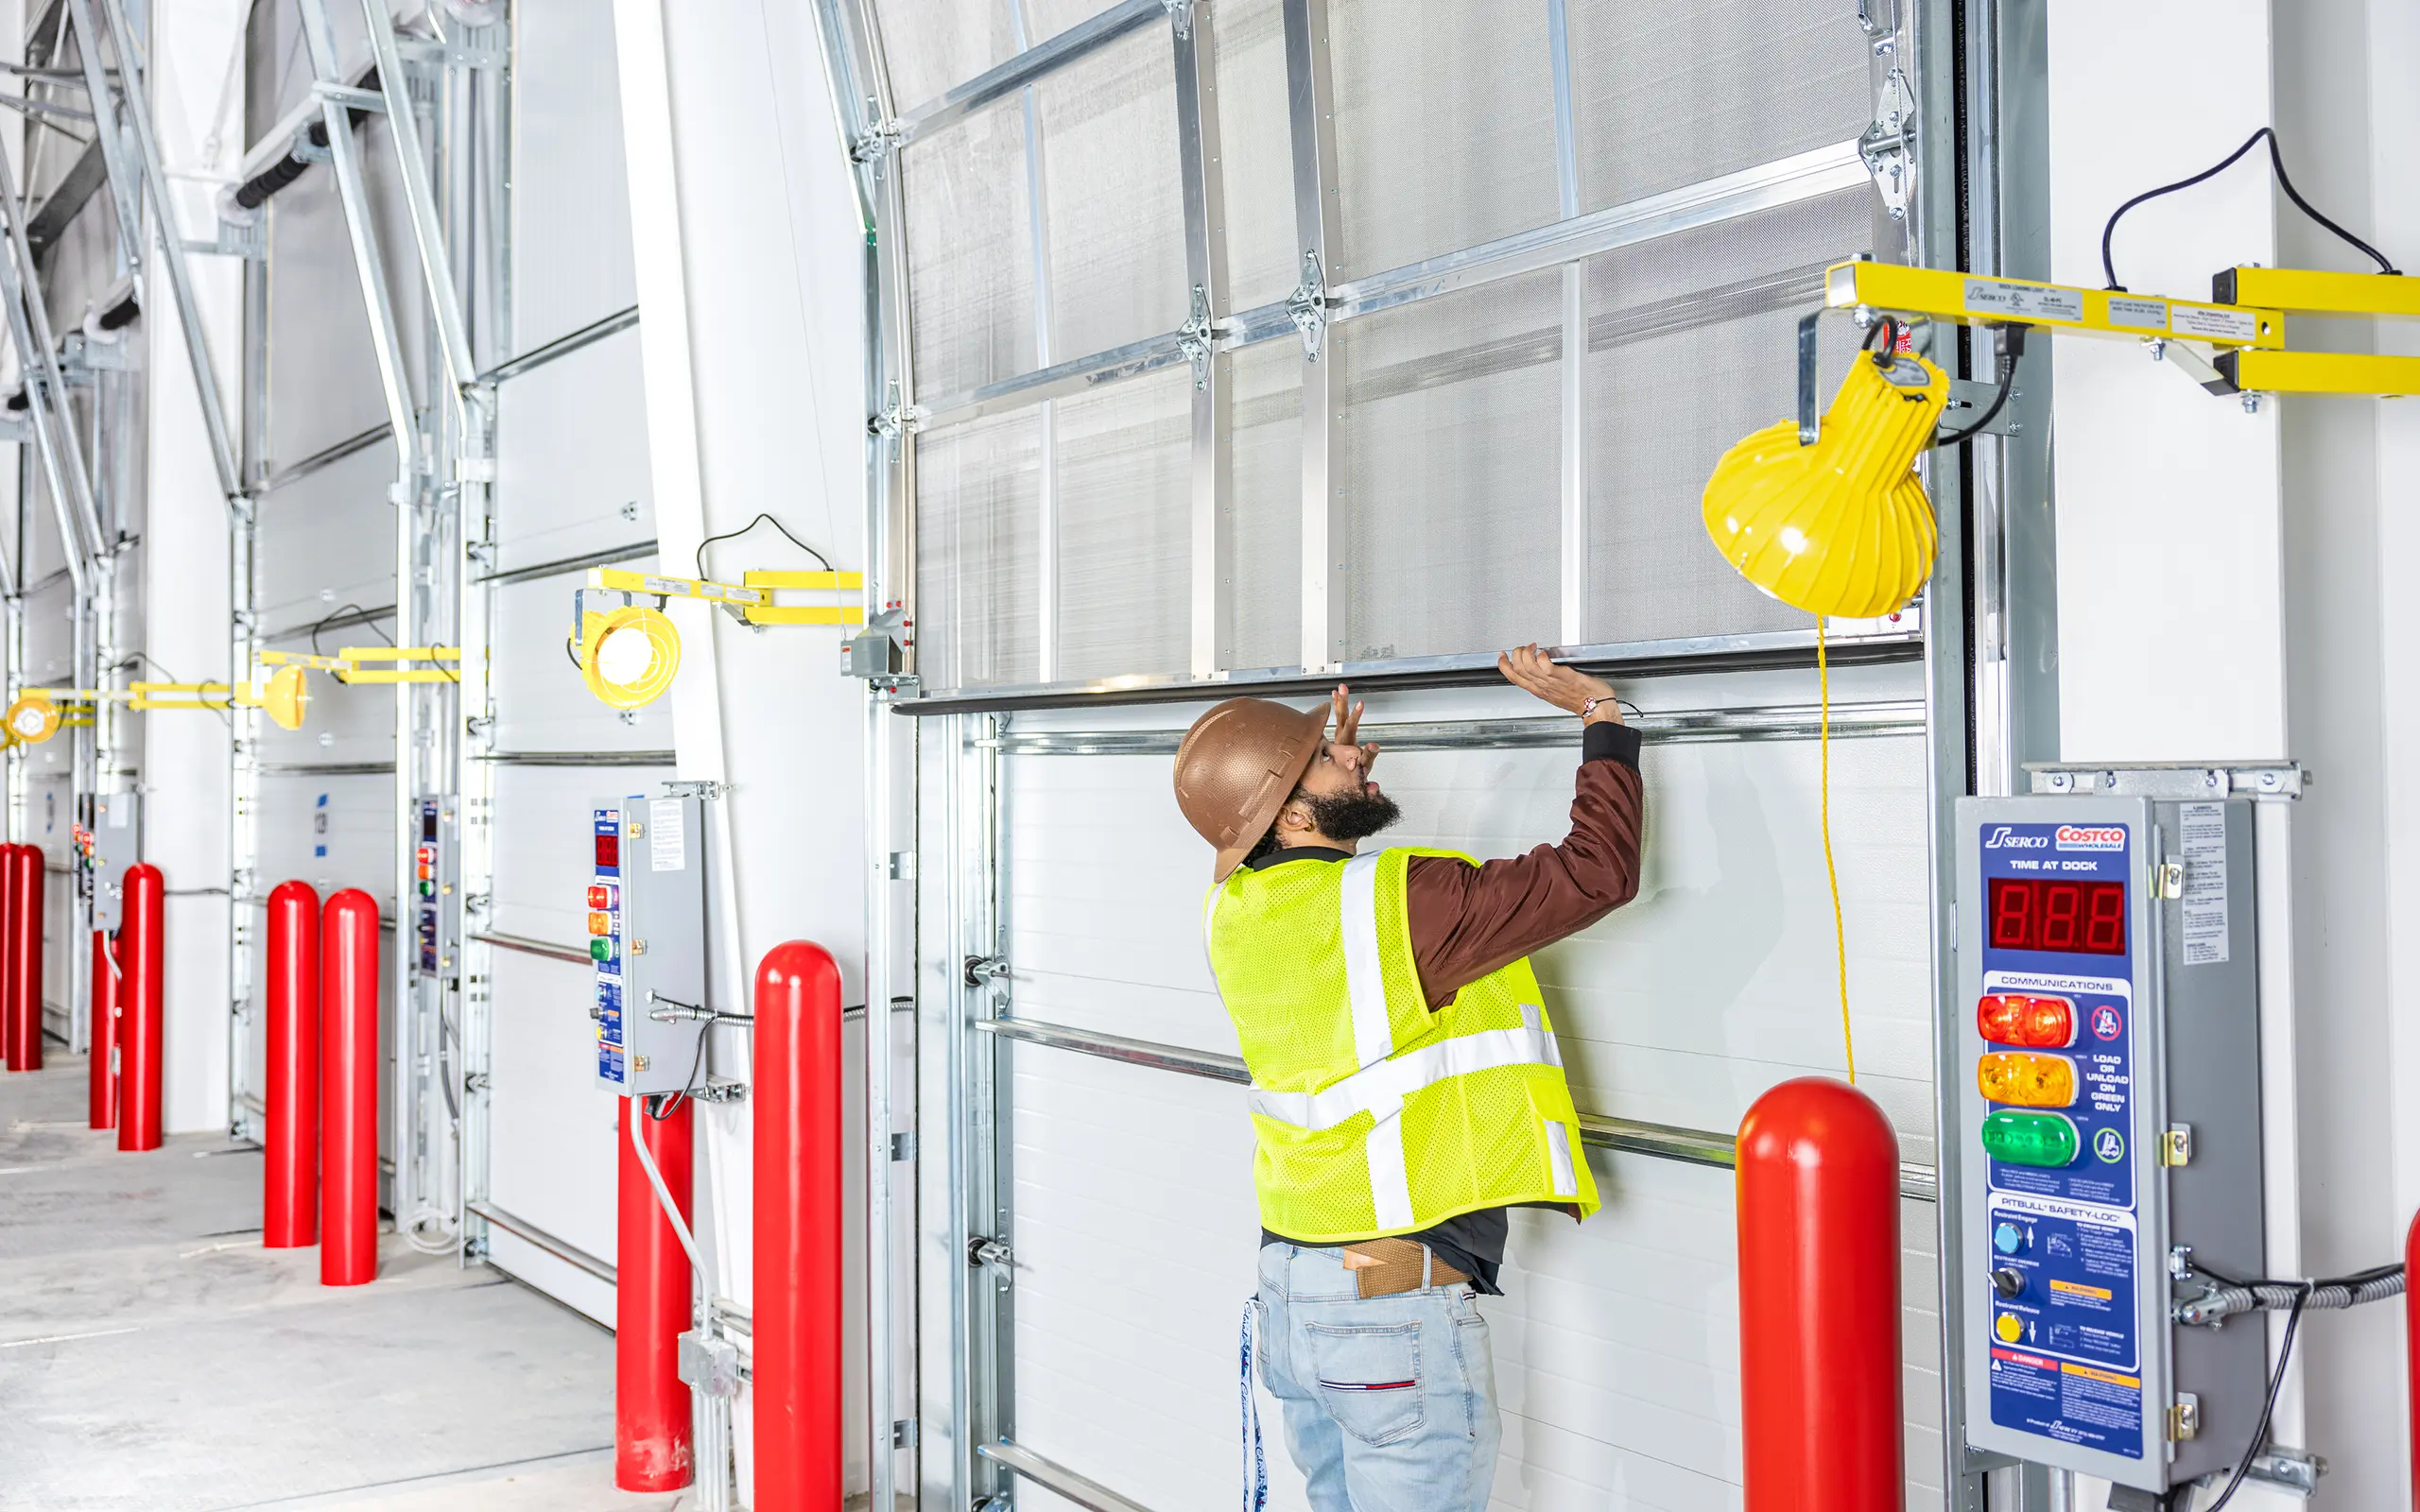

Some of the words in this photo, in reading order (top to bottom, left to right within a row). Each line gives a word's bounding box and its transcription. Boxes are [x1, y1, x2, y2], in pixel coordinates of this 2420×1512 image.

[2003, 835, 2049, 849] SERCO
[2010, 860, 2039, 870] TIME
[2042, 861, 2059, 870] AT
[2062, 861, 2098, 871] DOCK
[2000, 976, 2114, 991] COMMUNICATIONS
[2093, 1054, 2121, 1065] LOAD
[2100, 1064, 2115, 1074] OR
[2086, 1073, 2129, 1084] UNLOAD
[2100, 1083, 2116, 1092] ON
[2090, 1091, 2125, 1103] GREEN
[2095, 1102, 2121, 1112] ONLY
[2018, 1354, 2044, 1367] DANGER
